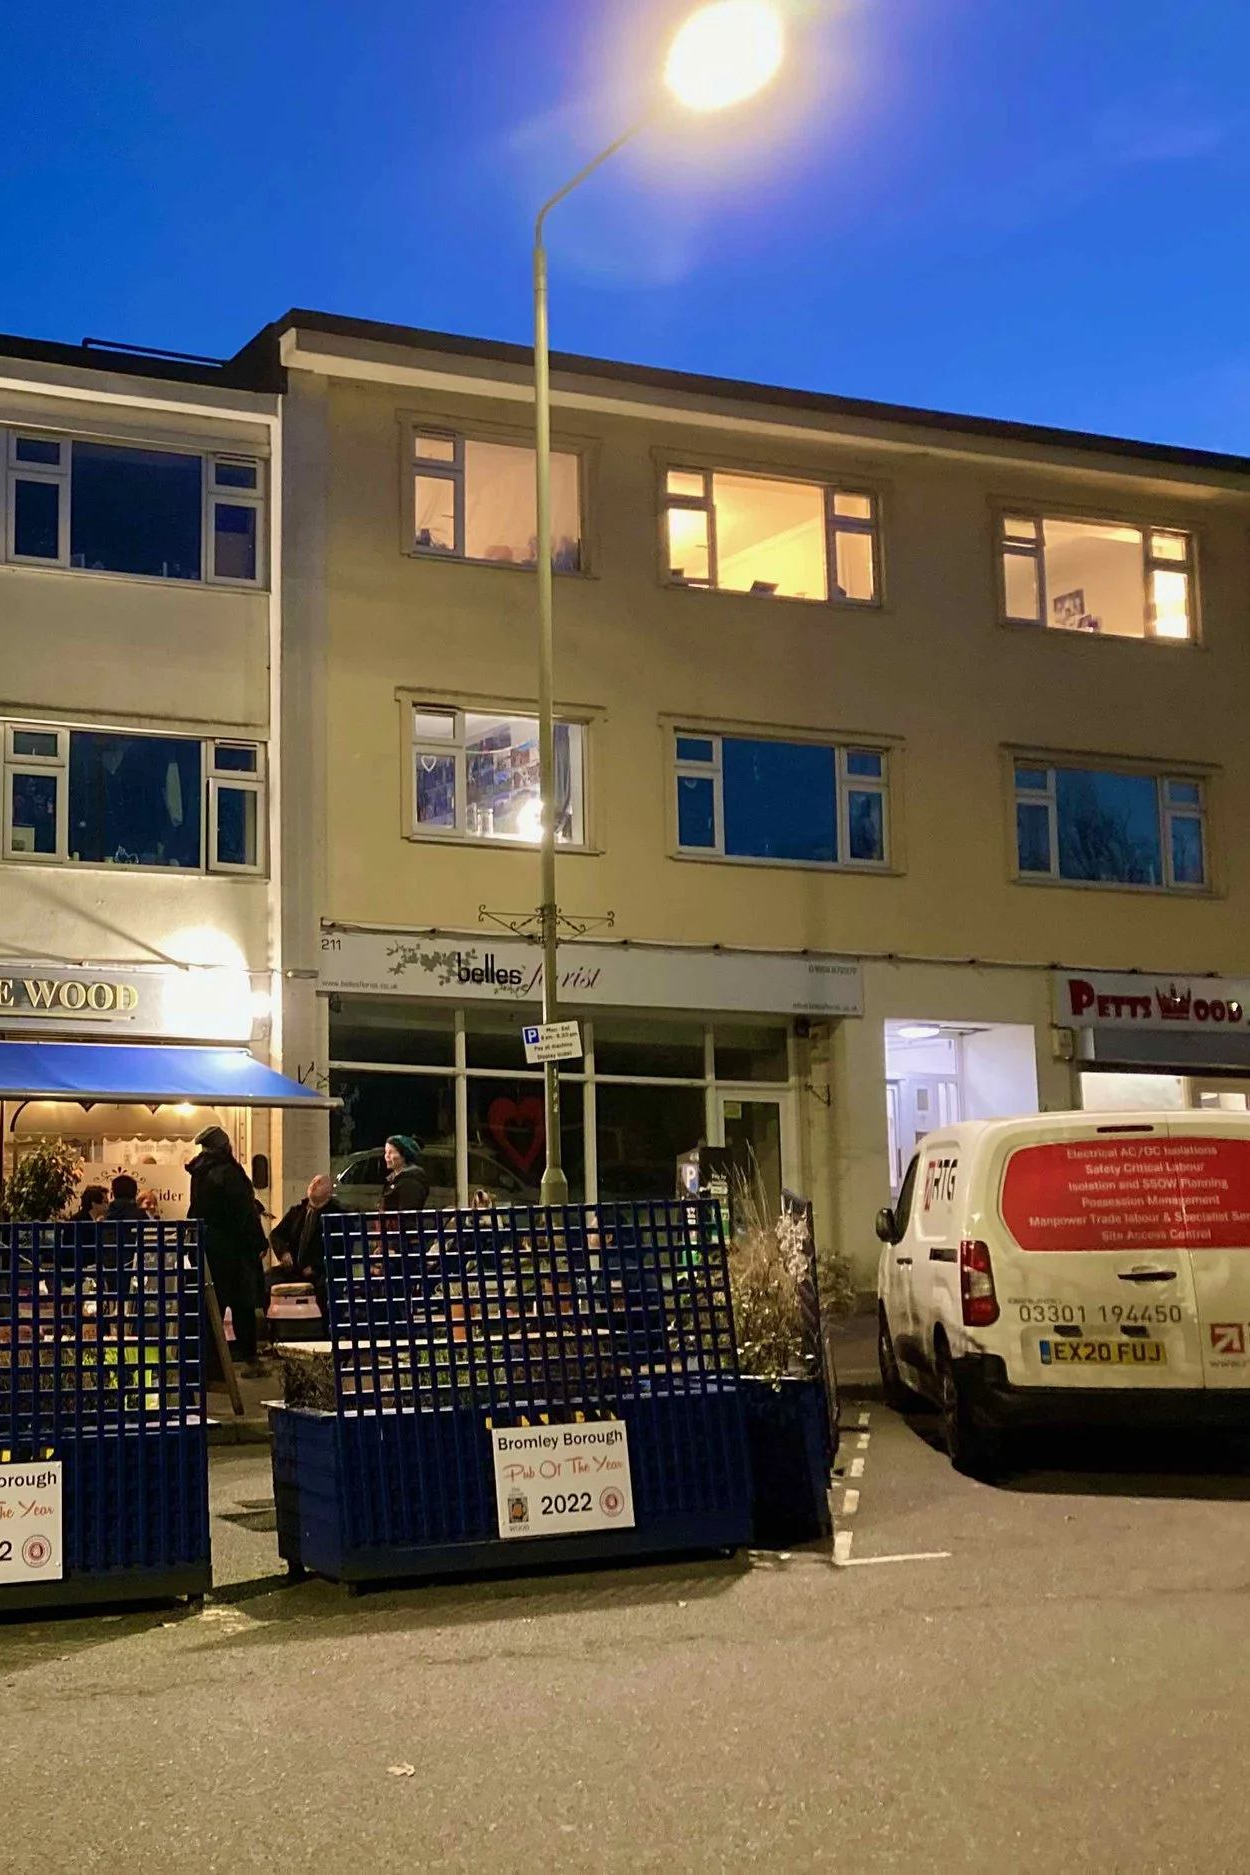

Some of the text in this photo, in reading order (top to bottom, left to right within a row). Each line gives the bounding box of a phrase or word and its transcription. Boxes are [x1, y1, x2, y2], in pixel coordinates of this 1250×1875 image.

[321, 939, 341, 951] 211
[457, 951, 601, 998] belles frist
[23, 979, 140, 1012] WOOD
[527, 1029, 537, 1043] P
[1067, 1148, 1118, 1159] Electrical
[1164, 1145, 1218, 1156] Isolations
[1085, 1161, 1205, 1175] Safety Critical Labour
[1069, 1181, 1116, 1192] Isolation
[1119, 1180, 1140, 1190] and
[1180, 1177, 1229, 1190] Planning
[1082, 1194, 1220, 1207] Possession Management
[1029, 1215, 1088, 1228] Manpower
[1091, 1214, 1122, 1224] Trade
[1124, 1213, 1159, 1223] labour
[1164, 1212, 1171, 1222] &
[1175, 1211, 1228, 1224] Specialist
[1102, 1228, 1211, 1241] Site Access Control
[1020, 1304, 1182, 1323] 03301 194450
[1053, 1342, 1161, 1362] EX20 FUJ
[498, 1430, 623, 1451] Bromley Borough
[502, 1455, 623, 1482] Pub Of The Year
[18, 1500, 55, 1518] Year
[541, 1492, 593, 1515] 2022
